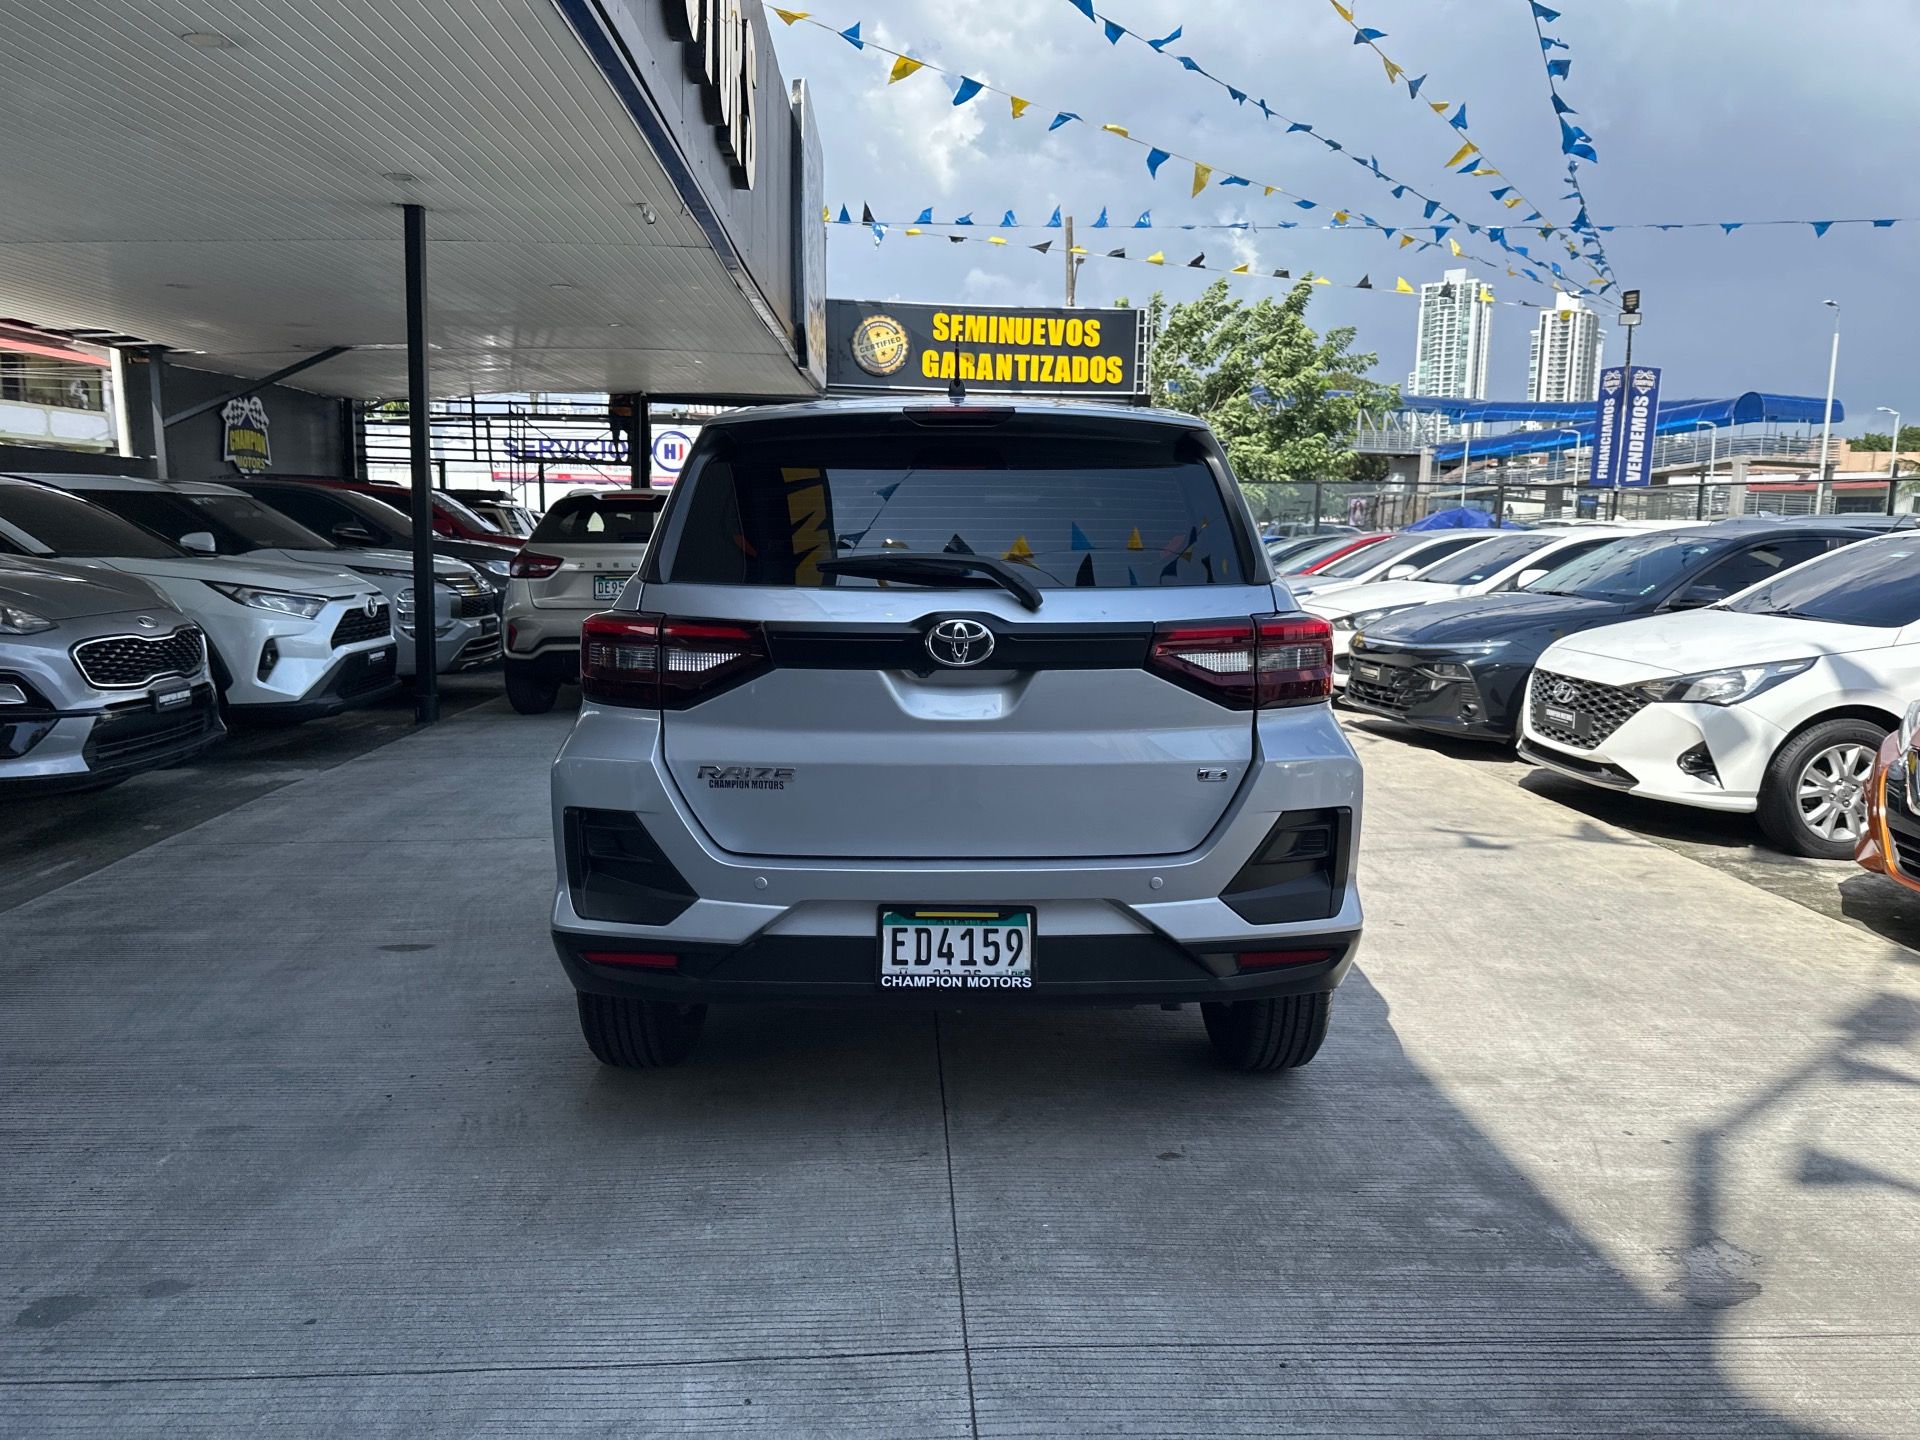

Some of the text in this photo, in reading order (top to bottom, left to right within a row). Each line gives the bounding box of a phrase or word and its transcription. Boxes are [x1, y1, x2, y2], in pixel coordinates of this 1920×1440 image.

[933, 312, 1101, 347] SEMINUEVOS
[860, 336, 902, 354] CERTIFIED
[922, 350, 1123, 384] GARANTIZADOS
[1597, 398, 1615, 480] FINANCIAMOS
[1626, 395, 1650, 482] VENDEMOS
[236, 455, 266, 470] MOTORS
[598, 582, 625, 594] DE95
[697, 766, 796, 779] RAIZE
[709, 780, 784, 790] CHAMPION MOTORS
[891, 927, 1024, 967] ED4159
[881, 976, 1032, 988] CHAMPION MOTORS
